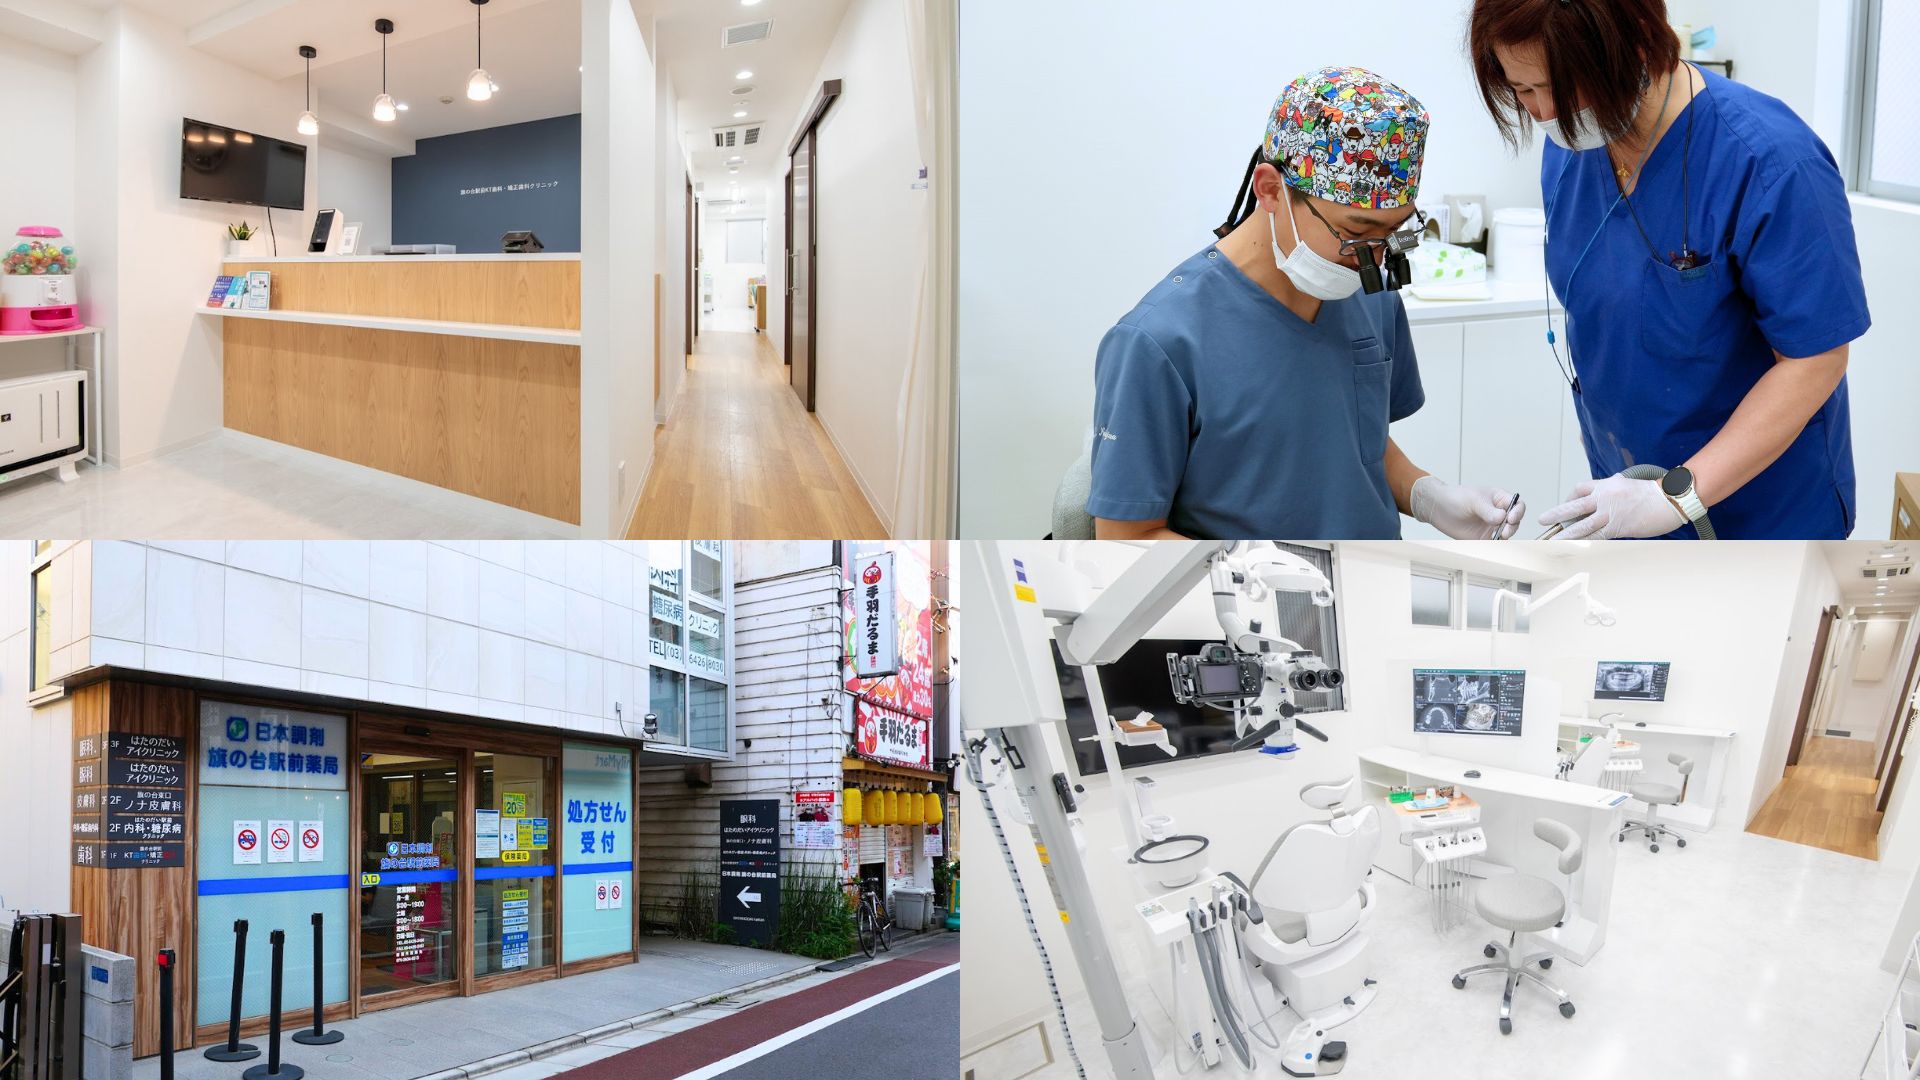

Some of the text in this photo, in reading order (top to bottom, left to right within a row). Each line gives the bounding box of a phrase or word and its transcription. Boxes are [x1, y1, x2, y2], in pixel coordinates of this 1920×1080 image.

[653, 596, 719, 635] 糖尿病 クリニック
[865, 585, 880, 655] 手羽だるま
[256, 721, 325, 746] 日本調剤
[879, 716, 918, 749] 手羽だるま
[110, 735, 175, 748] 3F はたのだい
[125, 745, 179, 759] アイクリニック
[208, 747, 339, 775] 旗の台駅前薬局
[130, 763, 175, 774] はたのだい
[125, 773, 179, 785] アイクリニック
[76, 793, 96, 808] 皮膚科
[109, 795, 122, 805] 2F
[125, 800, 182, 811] ノナ皮膚科
[568, 799, 627, 823] 処方せん
[740, 814, 756, 824] 眼科
[109, 823, 121, 832] 2F
[124, 823, 182, 834] 内科・糖尿病
[581, 831, 616, 854] 受付
[77, 845, 93, 864] 歯科
[363, 875, 378, 884] 入口
